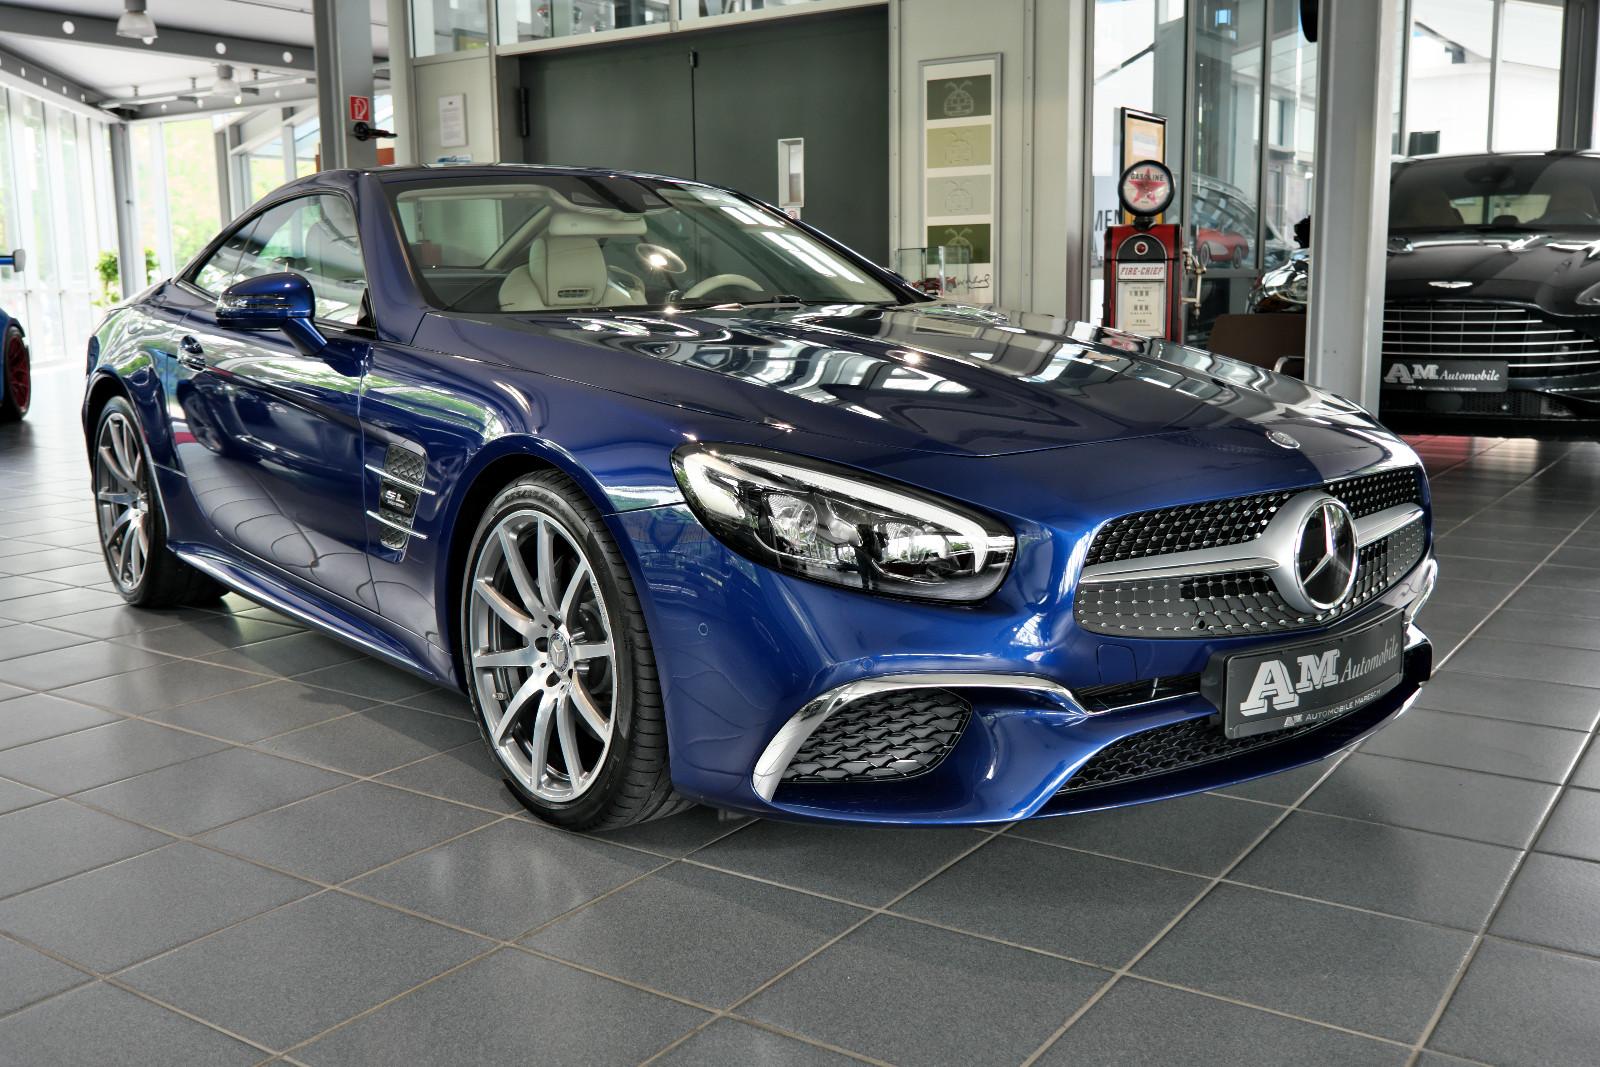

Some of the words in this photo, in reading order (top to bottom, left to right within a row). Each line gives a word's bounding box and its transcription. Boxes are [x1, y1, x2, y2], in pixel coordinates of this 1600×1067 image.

[1120, 266, 1163, 276] FIRE-CHIEF
[1384, 363, 1439, 383] AM
[1440, 369, 1500, 381] Automobile
[386, 490, 406, 503] SL
[1240, 649, 1341, 717] AM
[1340, 634, 1399, 683] Automobile
[1305, 701, 1354, 721] AUTOMOBILE
